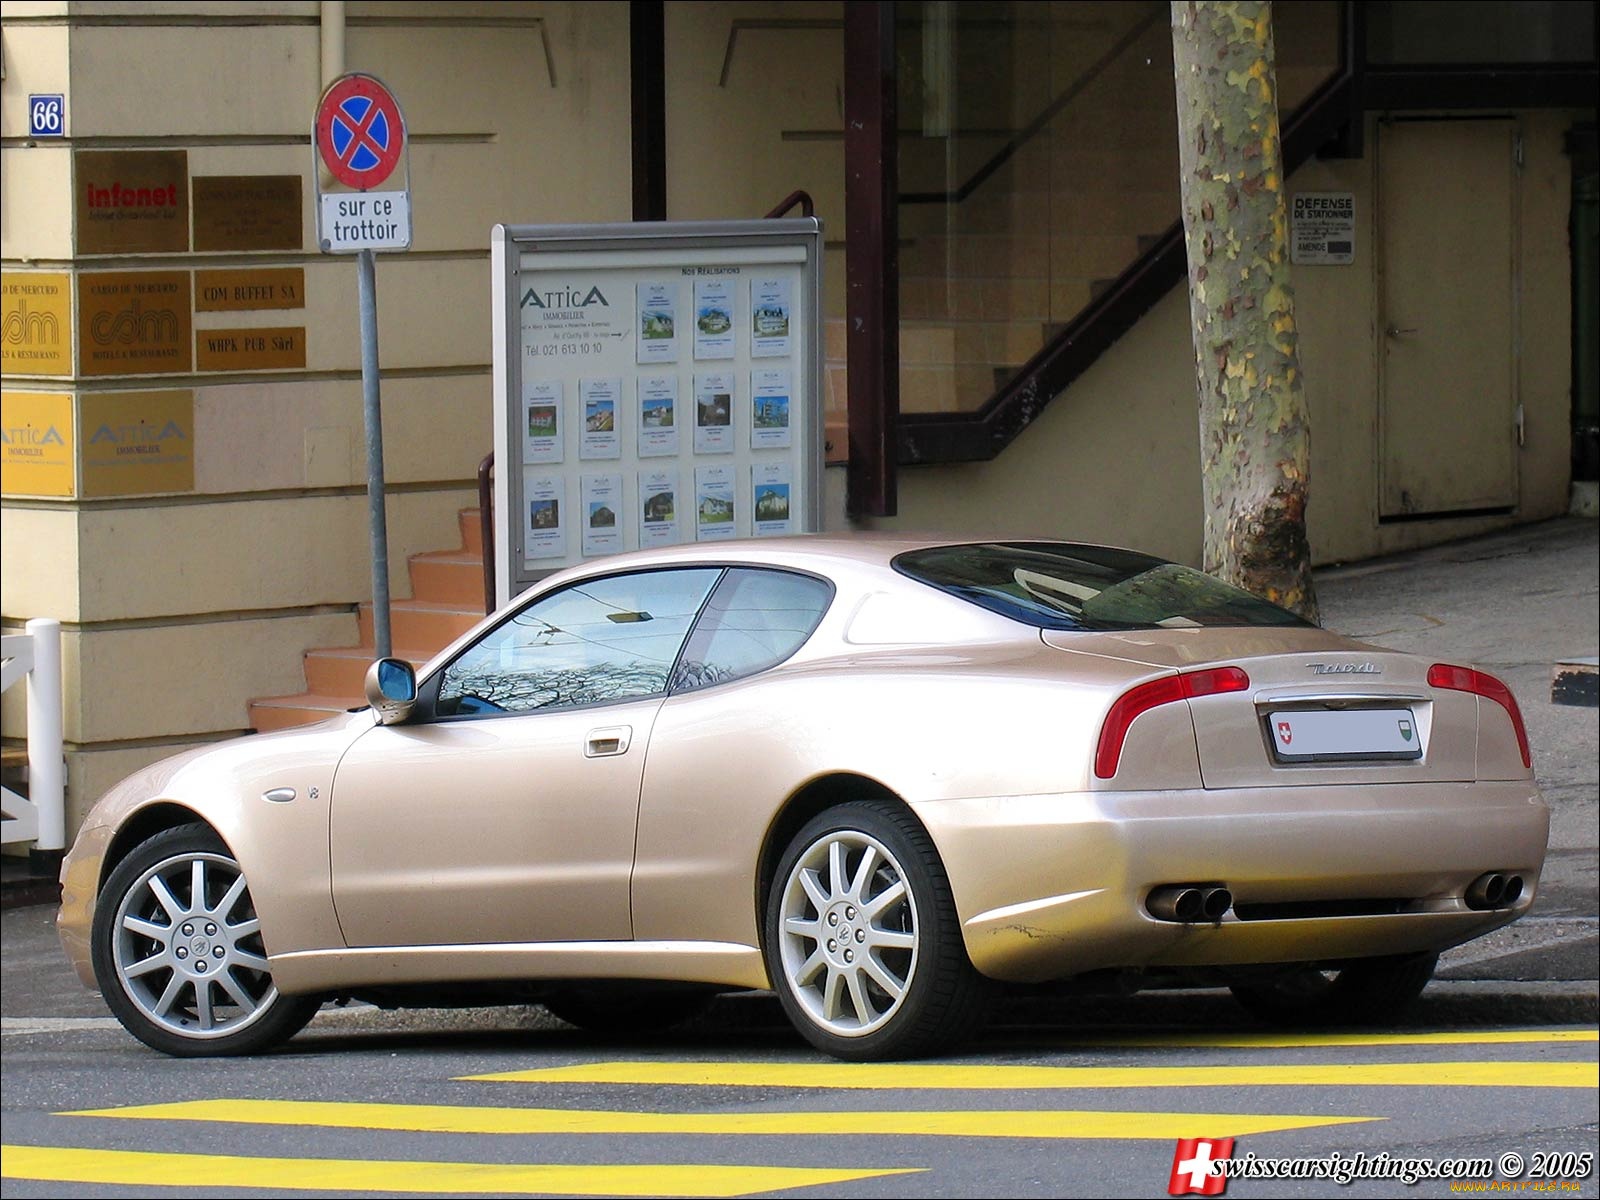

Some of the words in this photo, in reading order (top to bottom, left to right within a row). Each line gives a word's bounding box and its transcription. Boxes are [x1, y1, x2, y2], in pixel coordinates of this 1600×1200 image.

[33, 102, 60, 130] 66
[339, 200, 366, 217] sur
[373, 199, 392, 216] ce
[1295, 198, 1352, 209] DEFENSE
[1294, 209, 1305, 219] DE
[1307, 209, 1353, 219] STATIONNER
[333, 219, 398, 241] trottoir
[1297, 241, 1326, 251] AMENDE
[9, 285, 20, 295] DE
[21, 285, 59, 295] MERCURIO
[120, 284, 131, 294] DE
[204, 287, 228, 301] CDM
[234, 285, 273, 300] BUFFET
[281, 285, 296, 299] SA
[91, 298, 178, 346] cdm
[543, 311, 585, 321] IMMOBILIER
[207, 338, 238, 353] WHPK
[244, 336, 266, 352] PUB
[542, 344, 558, 356] 021
[561, 343, 577, 355] 613
[580, 343, 590, 354] 10
[592, 342, 602, 353] 10
[18, 350, 60, 359] RESTAURANTS
